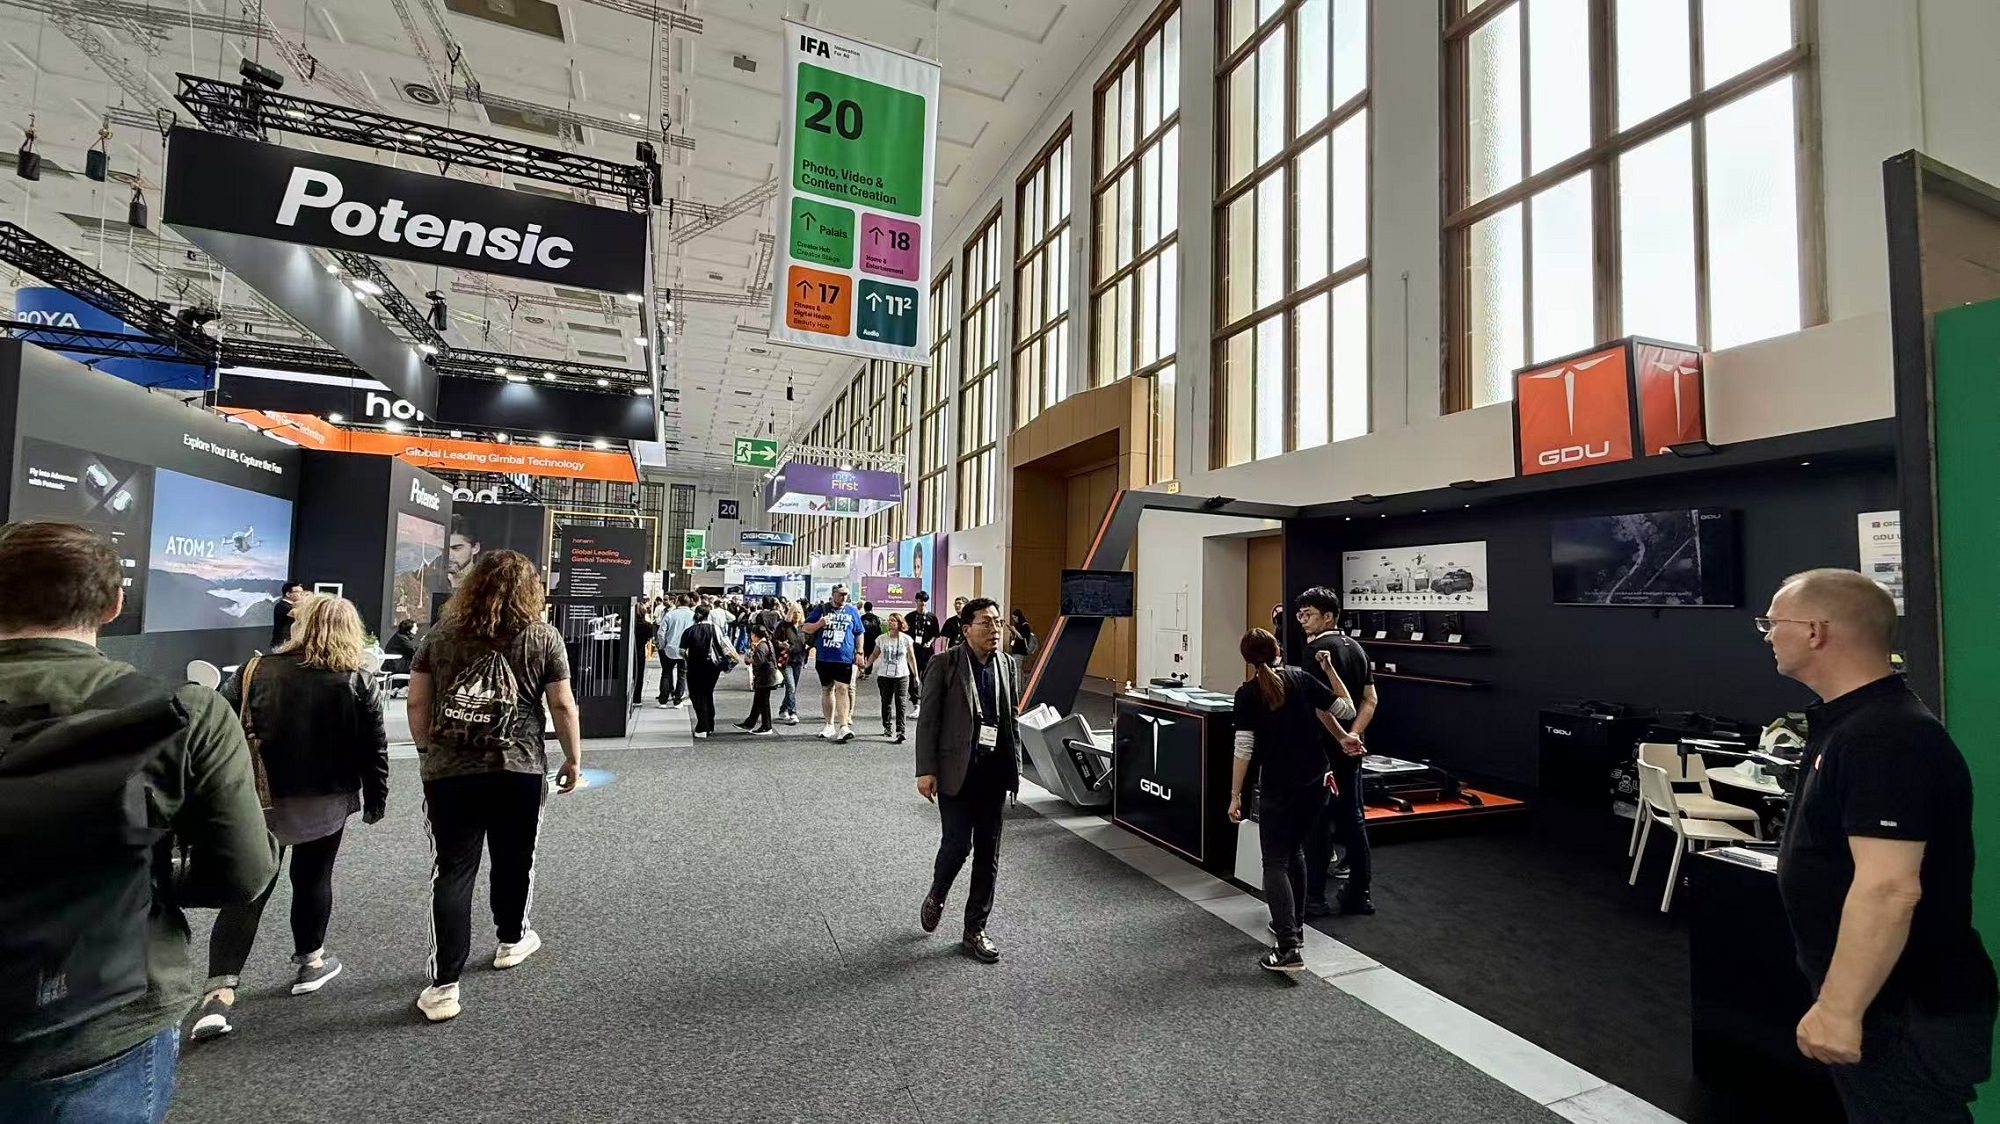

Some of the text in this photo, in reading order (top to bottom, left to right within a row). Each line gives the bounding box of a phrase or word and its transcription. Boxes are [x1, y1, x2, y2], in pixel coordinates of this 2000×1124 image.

[801, 35, 830, 59] IFA
[804, 91, 863, 140] 20
[802, 159, 883, 188] Photo, Video &
[802, 173, 896, 204] Content Creation
[276, 167, 574, 269] Potensic
[820, 225, 848, 239] Palais
[889, 229, 910, 251] 18
[866, 255, 882, 263] Home
[866, 262, 904, 275] Entertainment
[818, 283, 840, 304] 17
[794, 301, 815, 310] Fitness
[794, 309, 812, 317] Digital
[794, 318, 816, 328] Beauty
[863, 329, 880, 337] Audio
[183, 433, 210, 452] Explore
[210, 442, 227, 457] Your
[240, 452, 262, 468] Capture
[262, 460, 272, 472] the
[405, 447, 585, 471] Global Leading Gimbal Technology
[1538, 440, 1610, 466] GDU
[410, 477, 440, 512] Potensic
[831, 481, 858, 491] First
[720, 504, 737, 515] 20
[1872, 533, 1894, 541] GDU
[165, 535, 215, 557] ATOM 2
[596, 557, 632, 565] Technology
[823, 639, 842, 648] WAS
[444, 706, 491, 723] adidas
[1553, 728, 1571, 736] GDU
[1140, 778, 1171, 800] GDU
